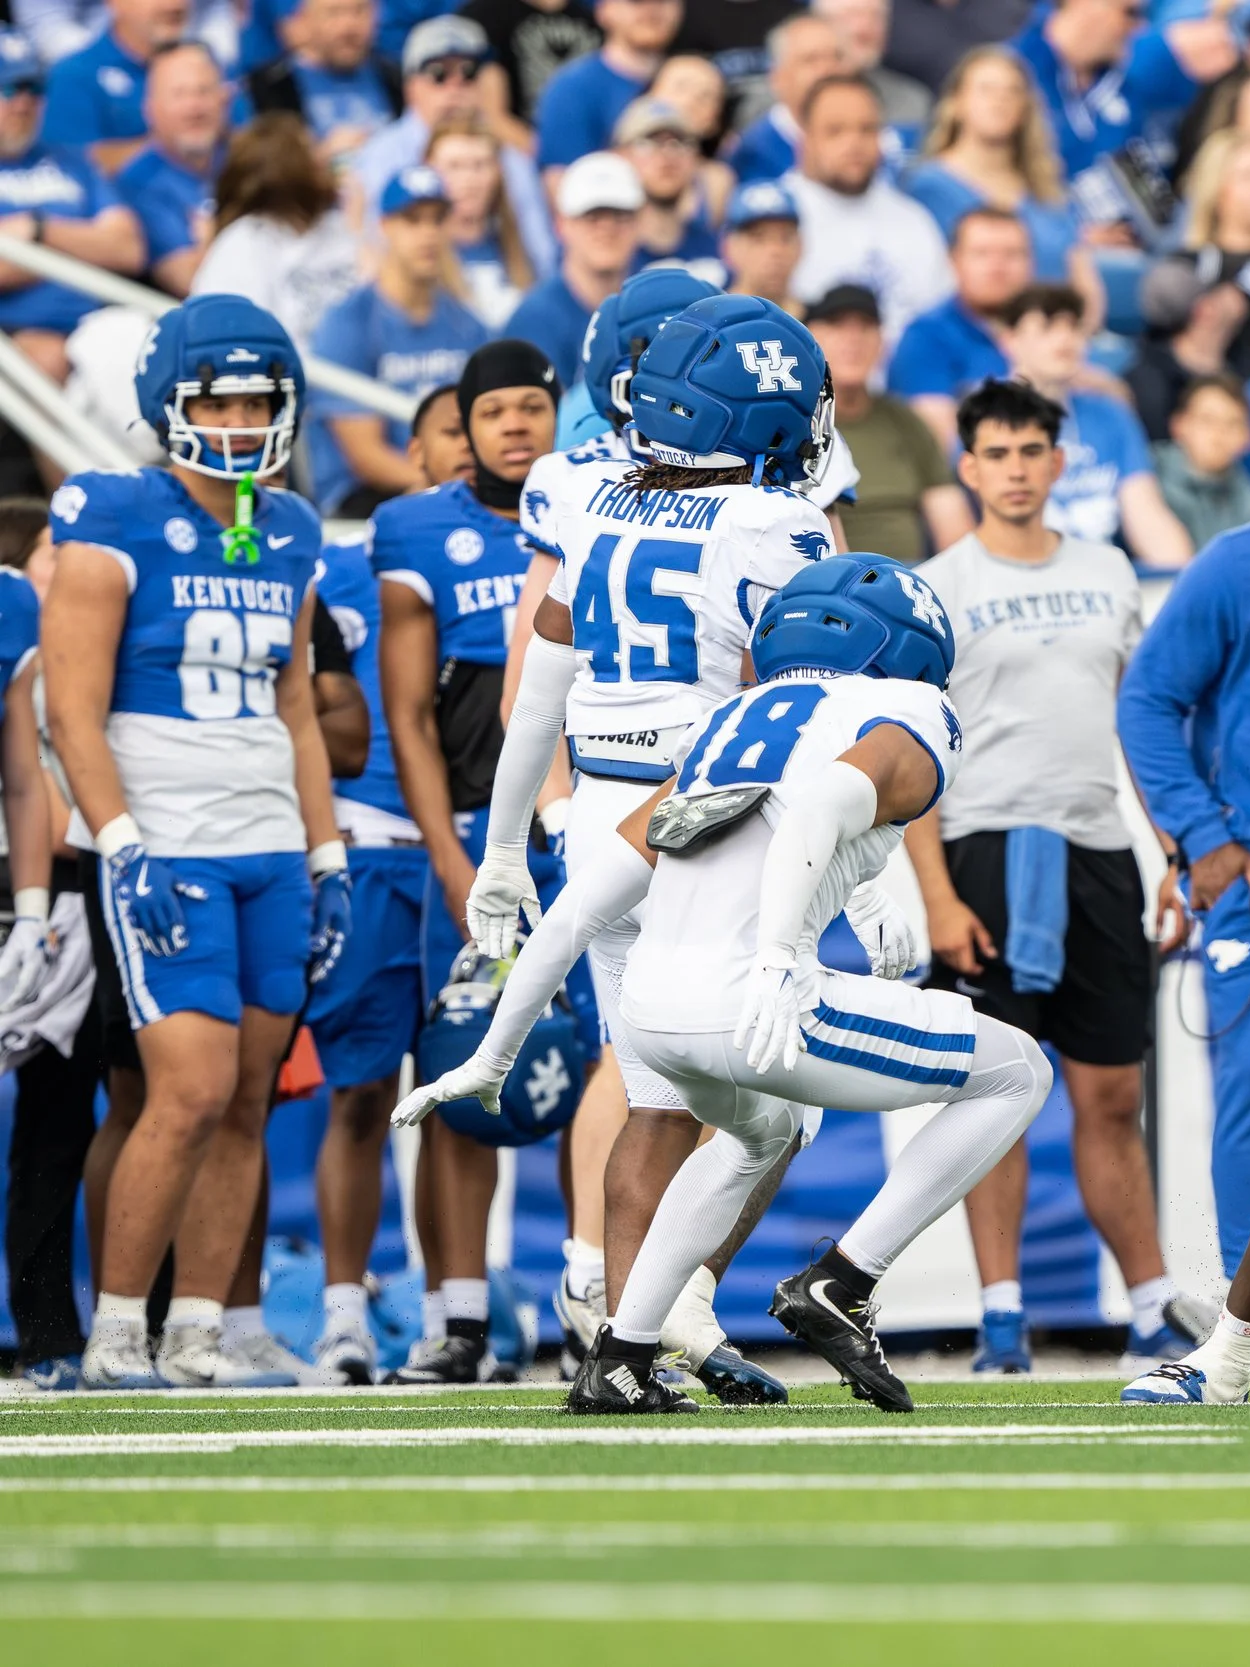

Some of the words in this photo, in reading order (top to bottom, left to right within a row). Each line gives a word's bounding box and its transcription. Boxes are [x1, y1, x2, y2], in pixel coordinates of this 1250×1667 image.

[735, 340, 803, 393] UK
[652, 448, 696, 466] NTUCKY
[585, 478, 729, 531] THOMPSON
[172, 575, 294, 616] KENTUCKY
[453, 573, 528, 615] KENT
[573, 532, 704, 685] 45
[894, 570, 947, 639] UK
[966, 588, 1116, 633] KENTUCKY
[178, 609, 293, 720] 85
[675, 683, 831, 794] 18
[604, 1364, 645, 1405] NIKE
